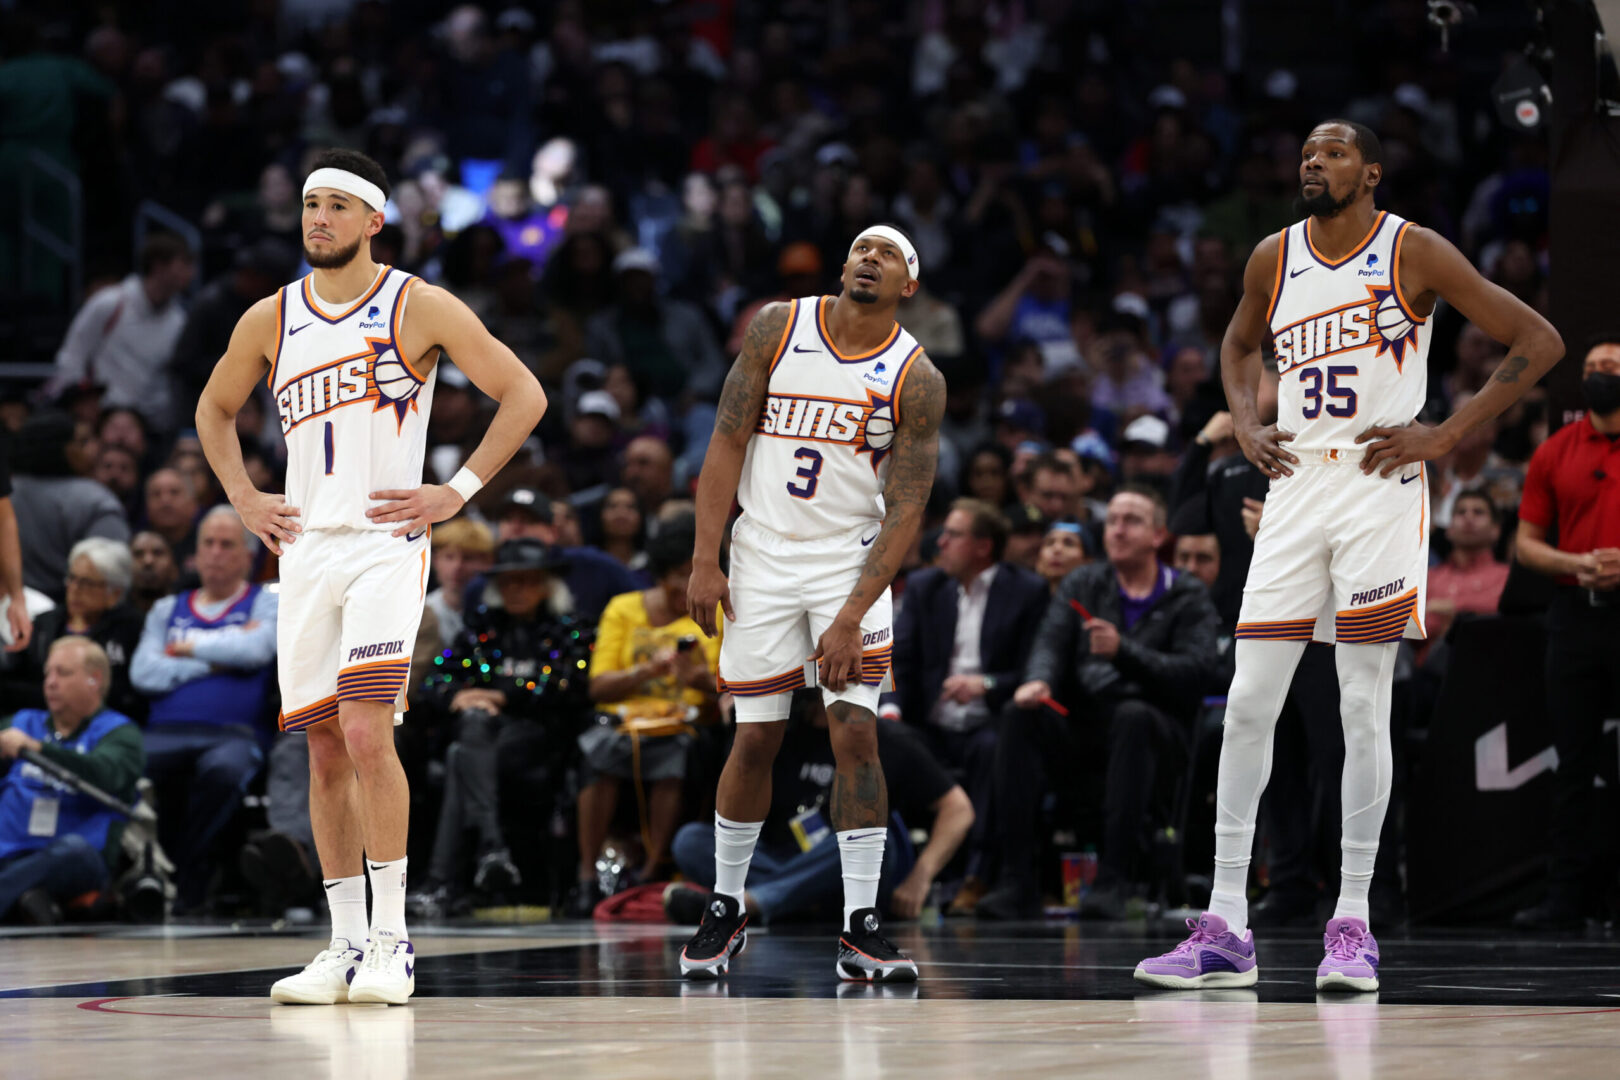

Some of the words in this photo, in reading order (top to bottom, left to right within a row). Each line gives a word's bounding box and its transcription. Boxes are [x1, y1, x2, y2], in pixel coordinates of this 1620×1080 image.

[1358, 269, 1384, 277] PayPal
[359, 321, 386, 330] PayPal
[1276, 305, 1370, 374] SUNS
[277, 358, 367, 435] SUNS
[863, 372, 889, 386] PayPal
[1299, 366, 1359, 420] 35
[764, 397, 864, 442] SUNS
[325, 421, 335, 476] 1
[787, 446, 824, 501] 3
[1350, 576, 1406, 606] PHOENIX
[348, 640, 405, 662] PHOENIX
[862, 626, 890, 647] OENIX
